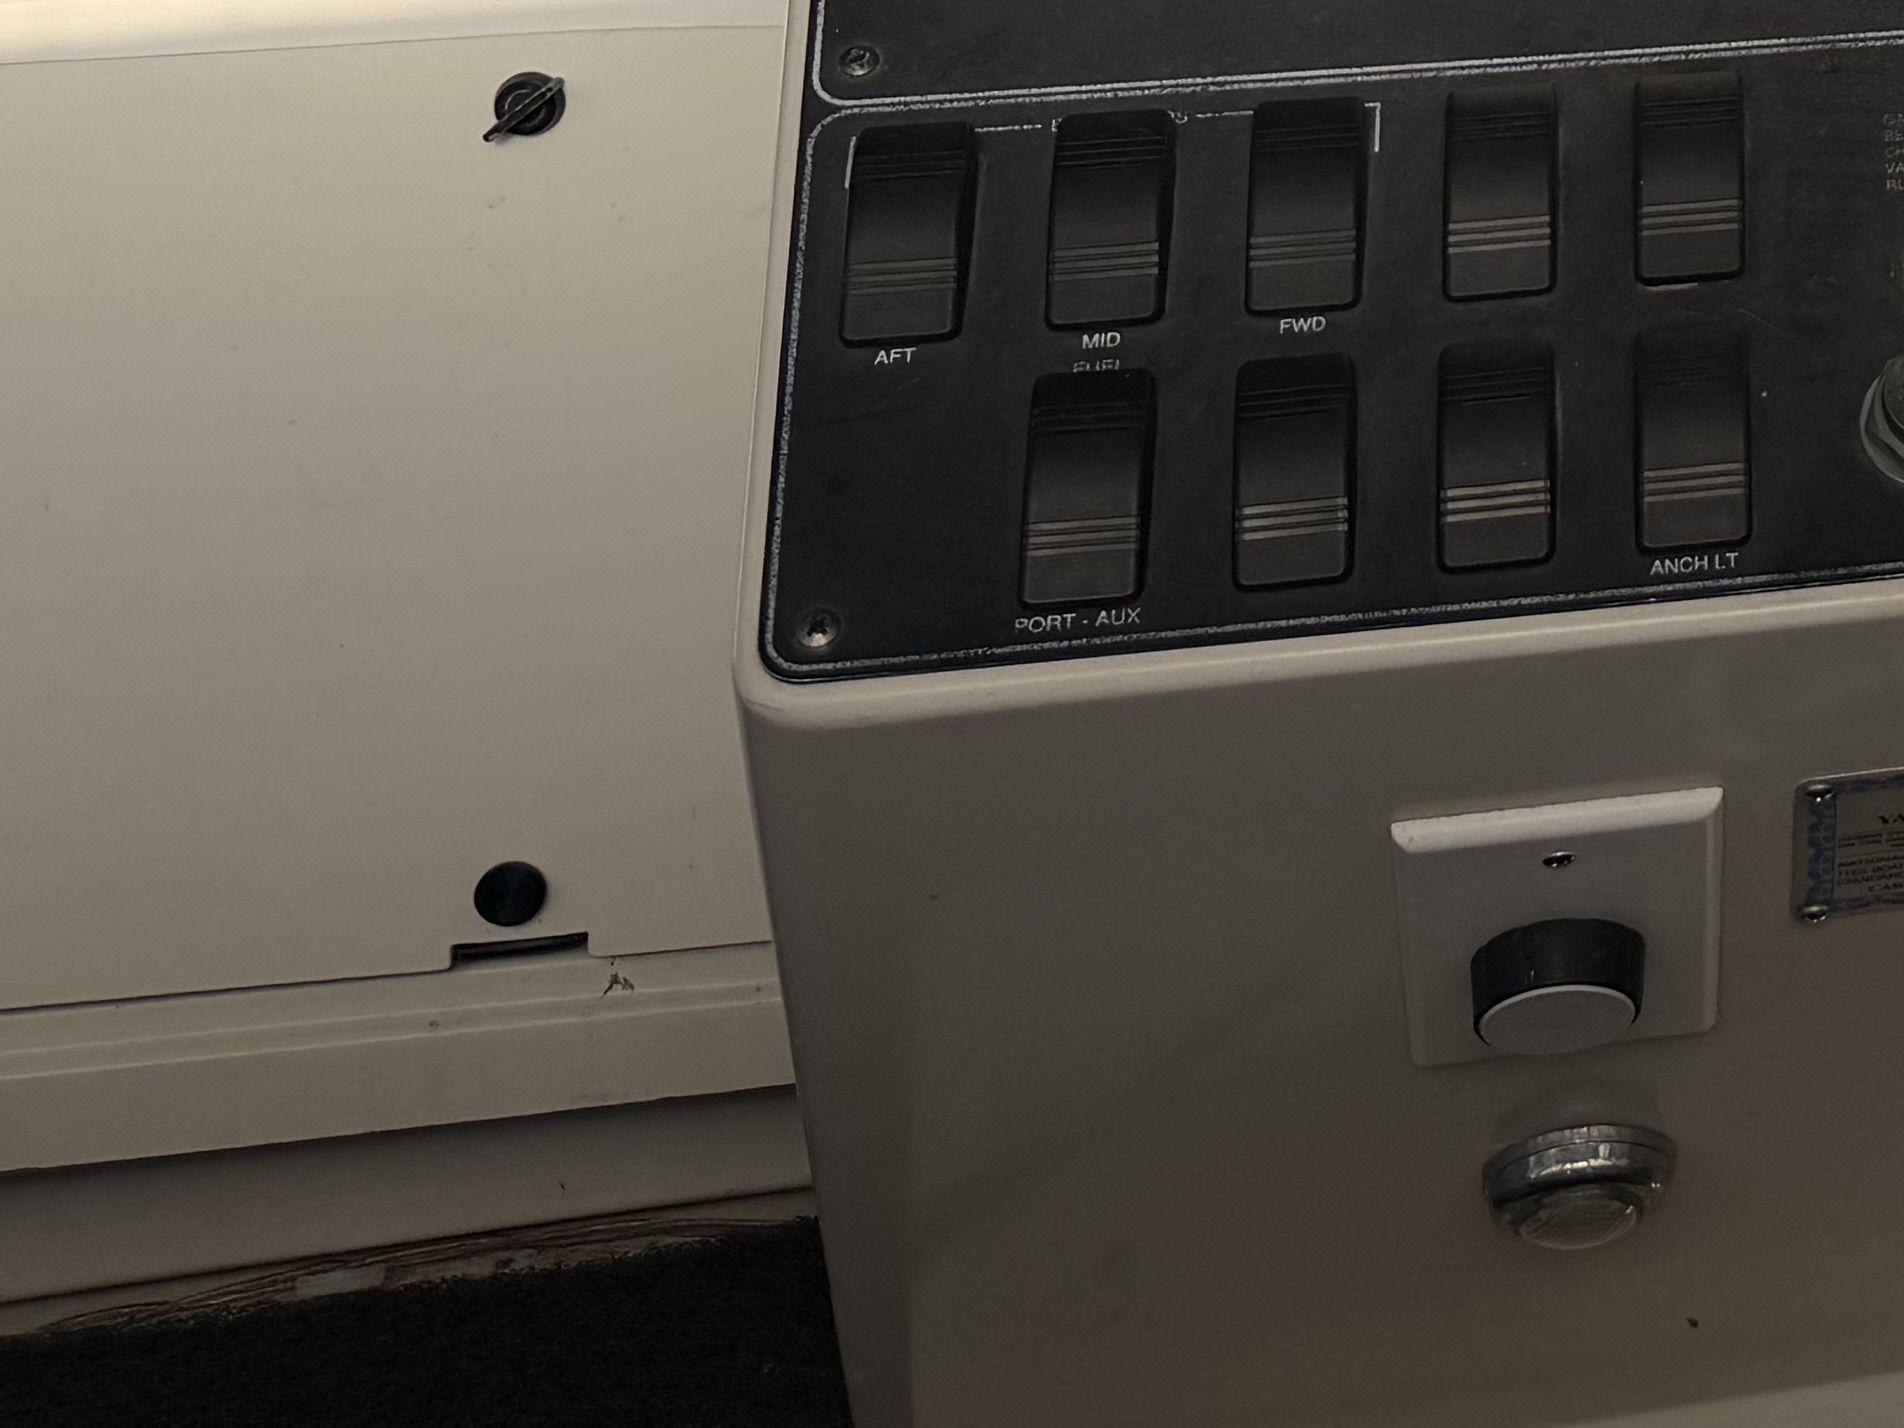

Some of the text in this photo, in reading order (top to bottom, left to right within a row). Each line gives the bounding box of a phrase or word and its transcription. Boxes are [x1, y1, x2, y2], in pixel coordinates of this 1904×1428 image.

[1278, 316, 1327, 335] FWD
[1082, 331, 1121, 350] MID
[874, 347, 917, 366] AFT
[1649, 552, 1739, 576] ANCH LT
[1014, 613, 1074, 635] PORT
[1094, 607, 1142, 627] AUX
